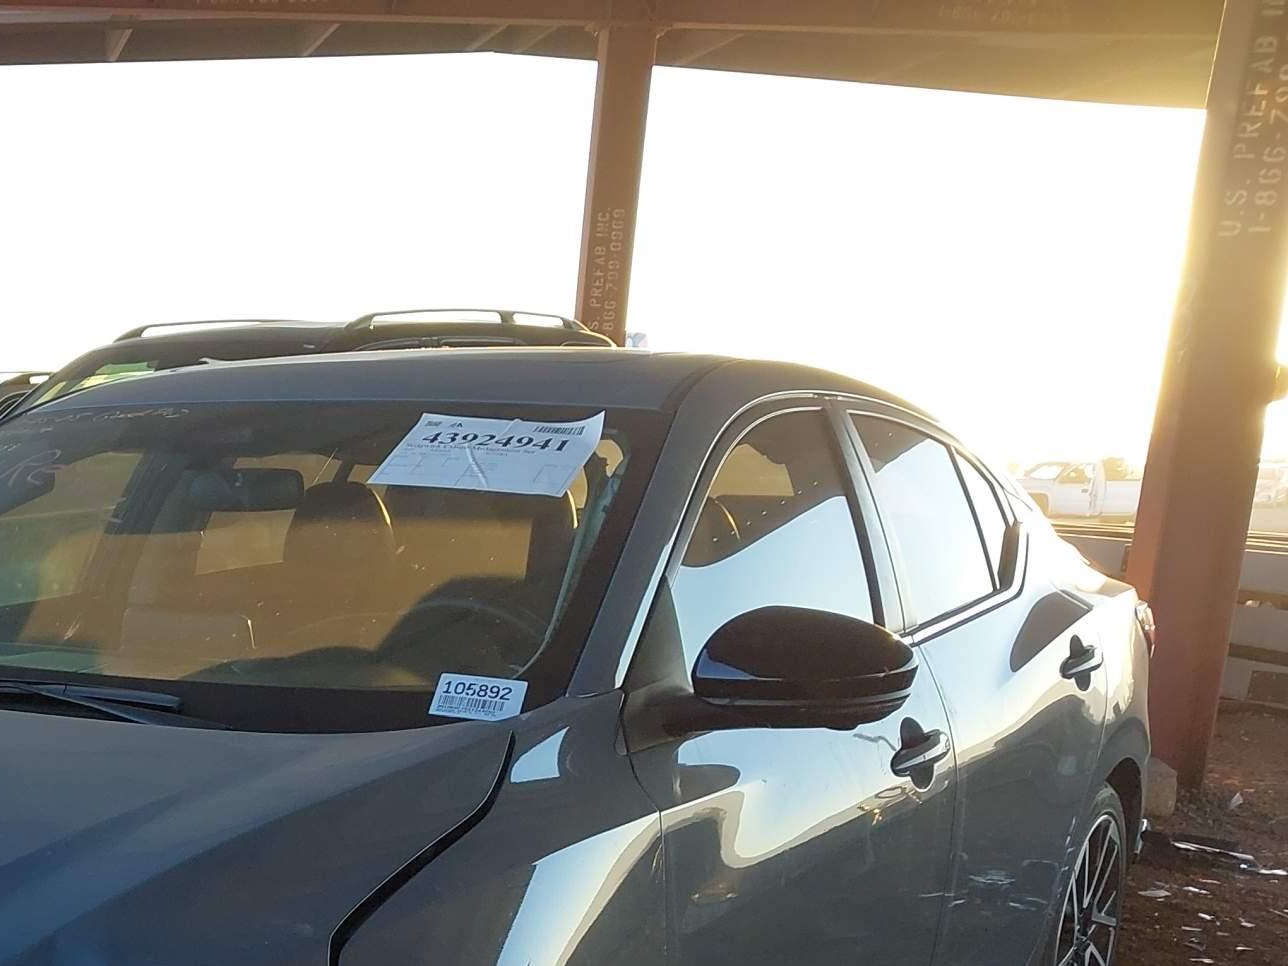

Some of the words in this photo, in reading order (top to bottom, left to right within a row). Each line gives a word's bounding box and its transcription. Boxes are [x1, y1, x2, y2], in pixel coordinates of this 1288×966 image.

[1233, 36, 1279, 160] PREFAB
[590, 246, 607, 308] PREFAB
[422, 431, 570, 452] 43924941
[442, 680, 513, 701] 105892
